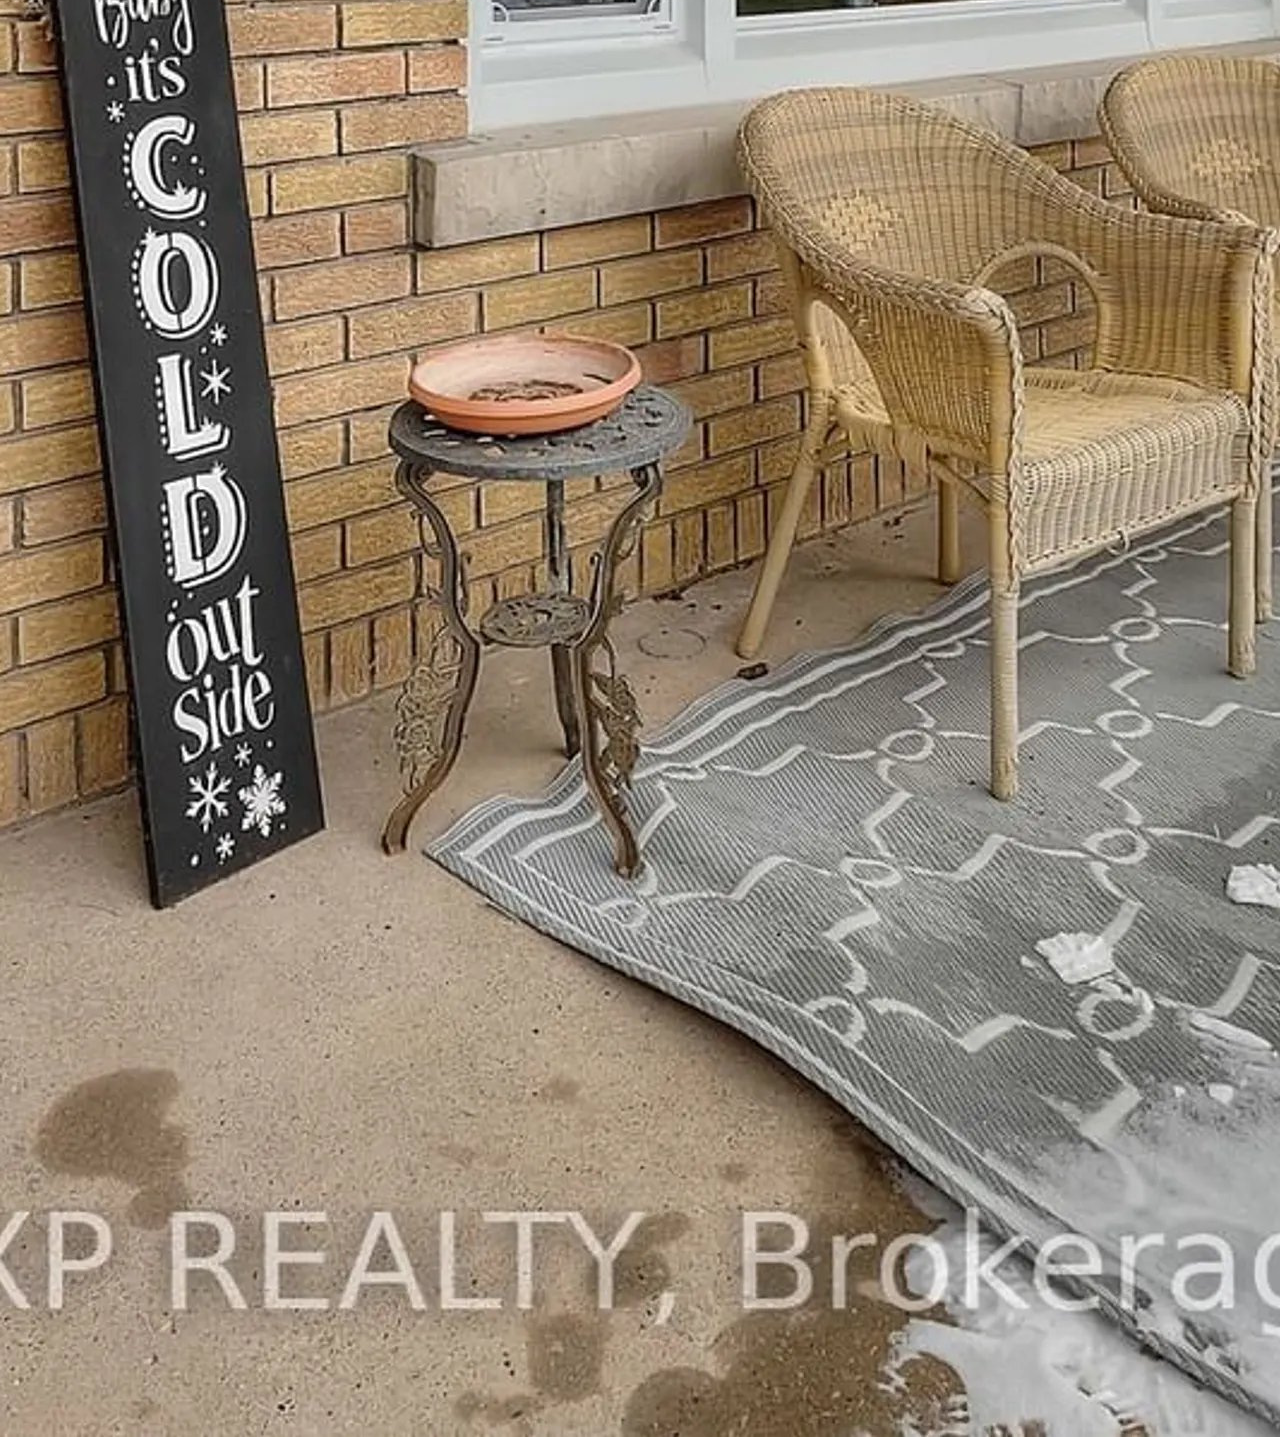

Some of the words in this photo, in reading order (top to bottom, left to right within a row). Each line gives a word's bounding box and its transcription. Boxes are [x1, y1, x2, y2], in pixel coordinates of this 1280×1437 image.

[123, 37, 187, 103] it's
[124, 115, 248, 589] COLD
[166, 574, 264, 682] out
